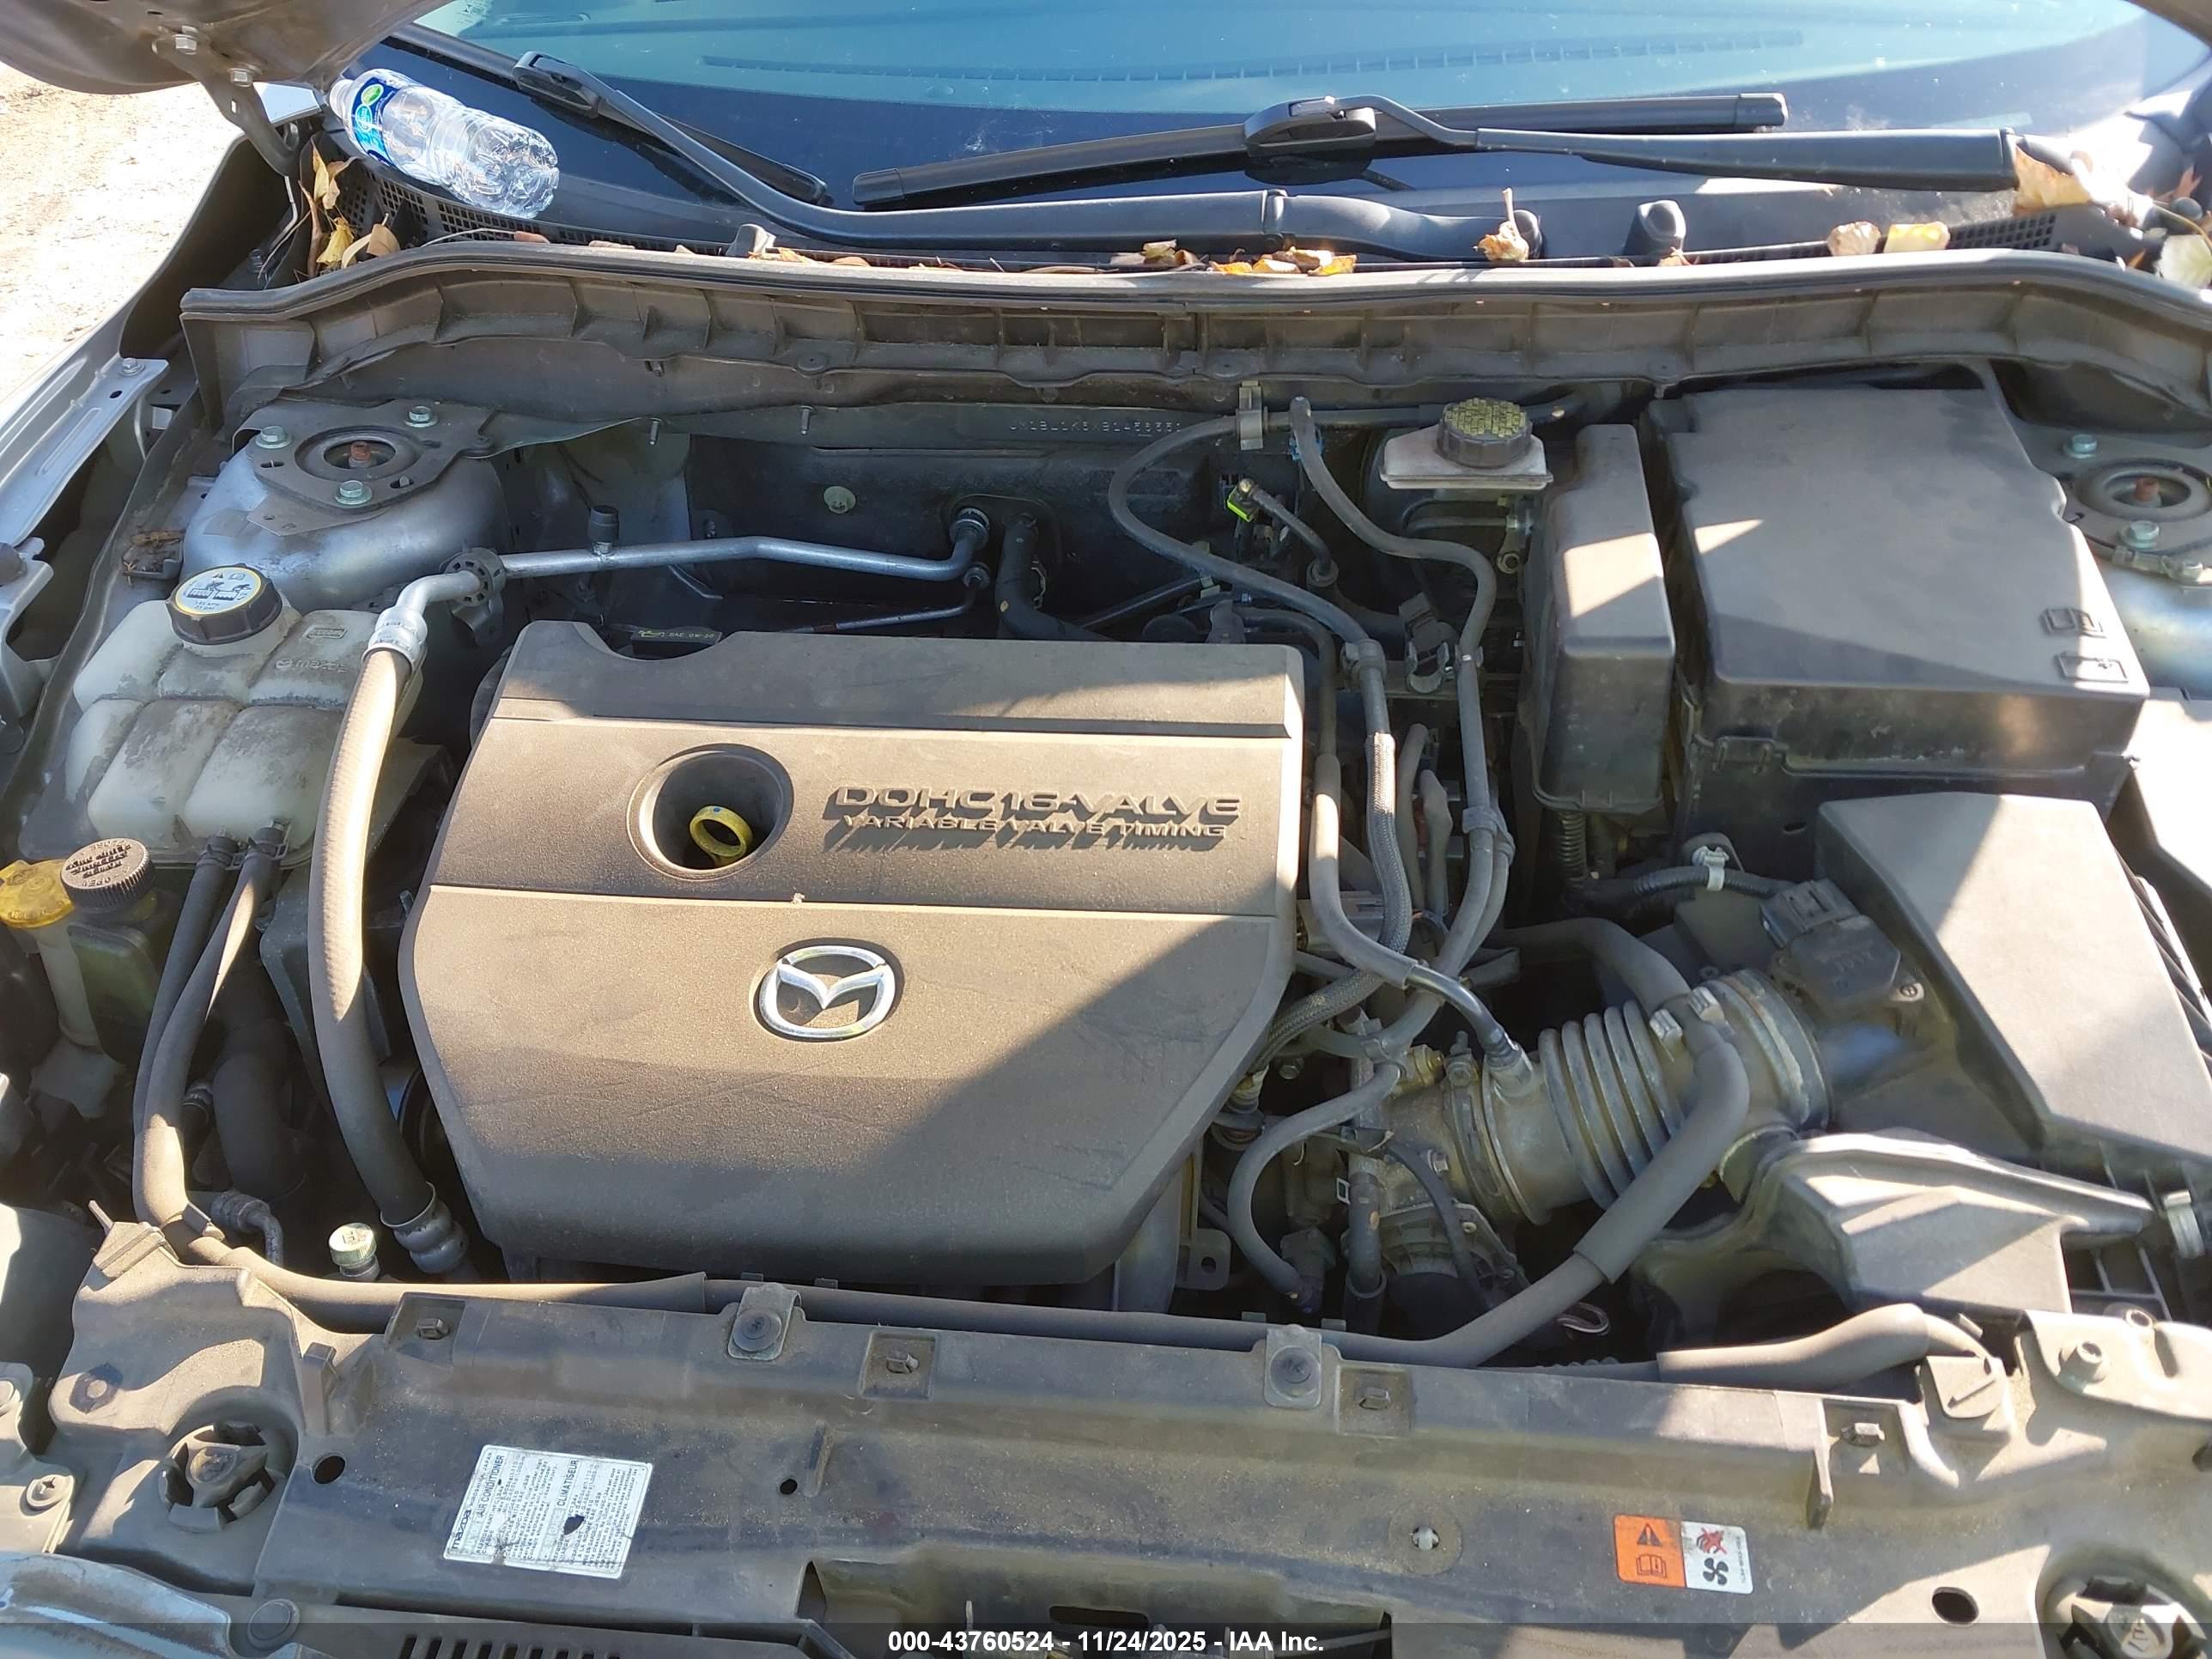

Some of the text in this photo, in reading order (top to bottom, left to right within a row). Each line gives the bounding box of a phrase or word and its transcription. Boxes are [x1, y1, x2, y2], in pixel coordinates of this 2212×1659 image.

[833, 785, 993, 810] DOHC
[842, 814, 1227, 839] VARIABLE VALVE TIMING
[480, 1454, 505, 1502] CONDITIONER
[556, 1459, 580, 1506] CLIMATISEUR
[475, 1503, 488, 1517] AIR
[450, 1509, 471, 1549] mazda
